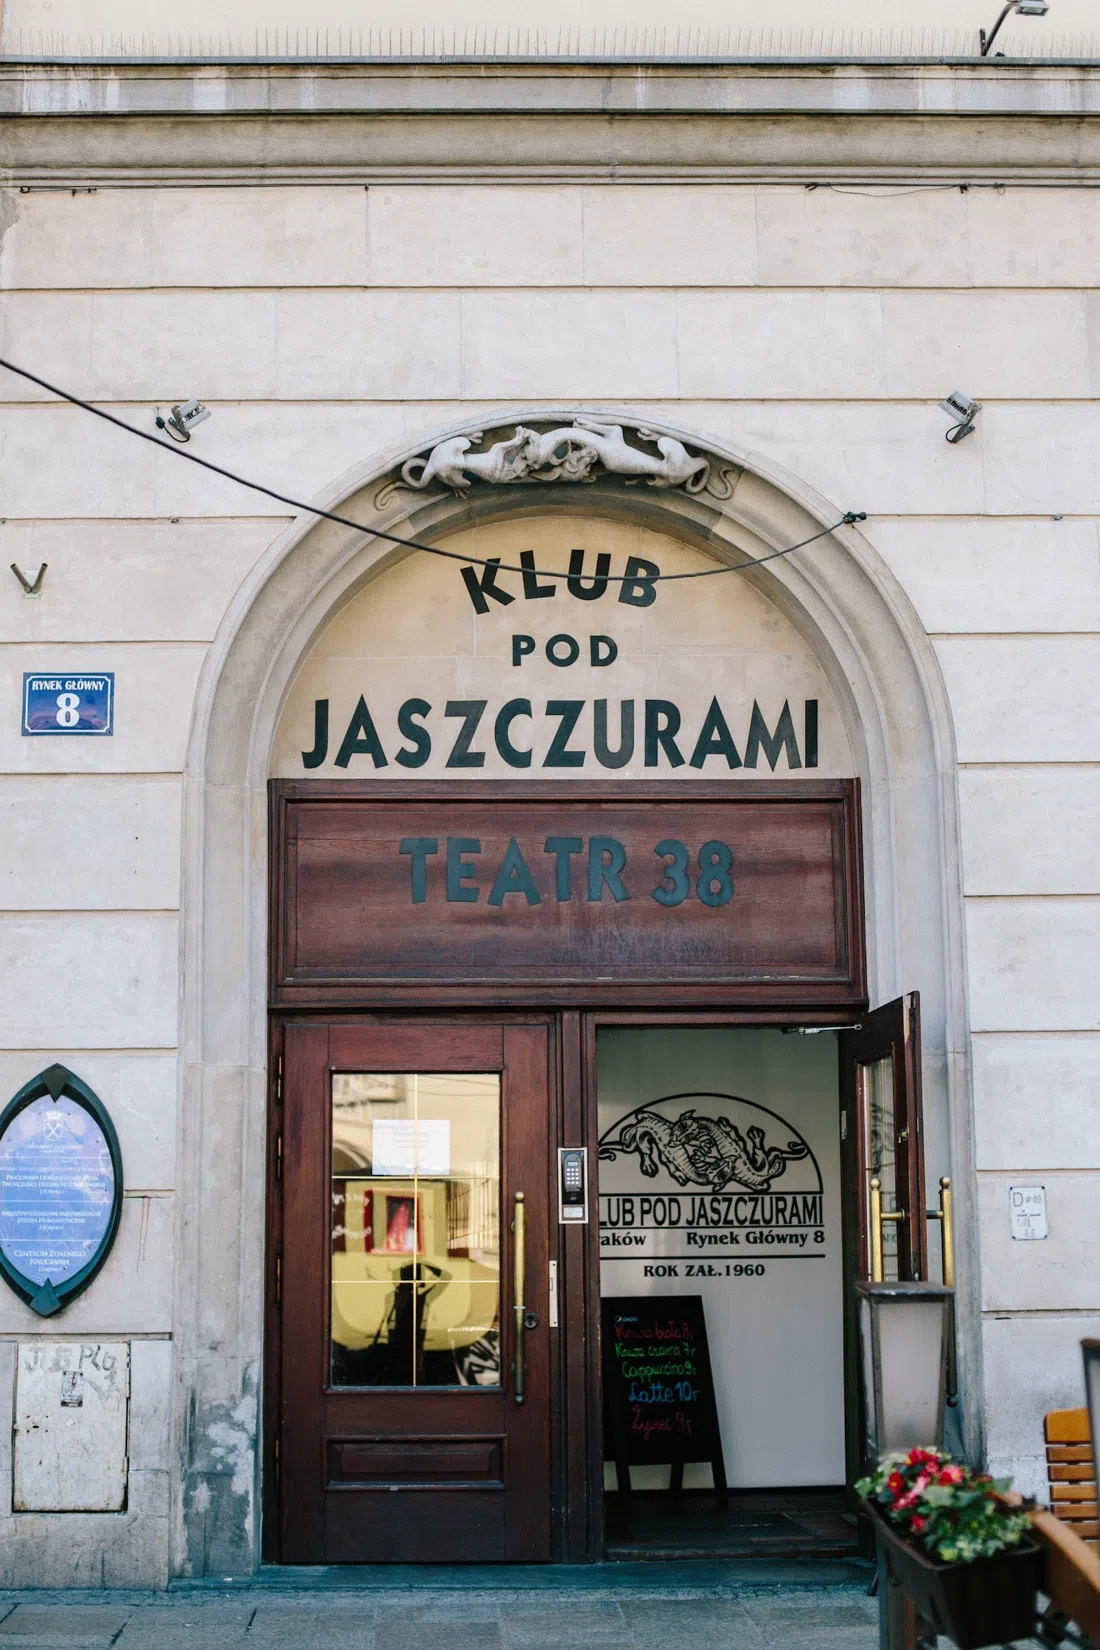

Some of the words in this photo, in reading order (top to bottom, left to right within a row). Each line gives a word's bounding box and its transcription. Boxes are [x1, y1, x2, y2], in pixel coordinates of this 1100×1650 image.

[460, 548, 661, 615] KLUB
[512, 633, 619, 667] POD
[32, 680, 63, 691] RYNEK
[65, 678, 105, 691] GŁÓWNY
[56, 692, 80, 727] 8
[301, 694, 819, 773] JASZCZURAMI
[399, 836, 631, 907] TEATR
[651, 839, 735, 907] 38
[640, 1197, 681, 1227] POD
[686, 1195, 824, 1226] JASZCZURAMI
[1013, 1192, 1024, 1207] D
[599, 1231, 647, 1246] aków
[686, 1231, 740, 1248] Rynek
[745, 1229, 809, 1247] Główny
[813, 1230, 825, 1244] 8
[644, 1264, 679, 1277] ROK
[628, 1381, 675, 1404] Latte
